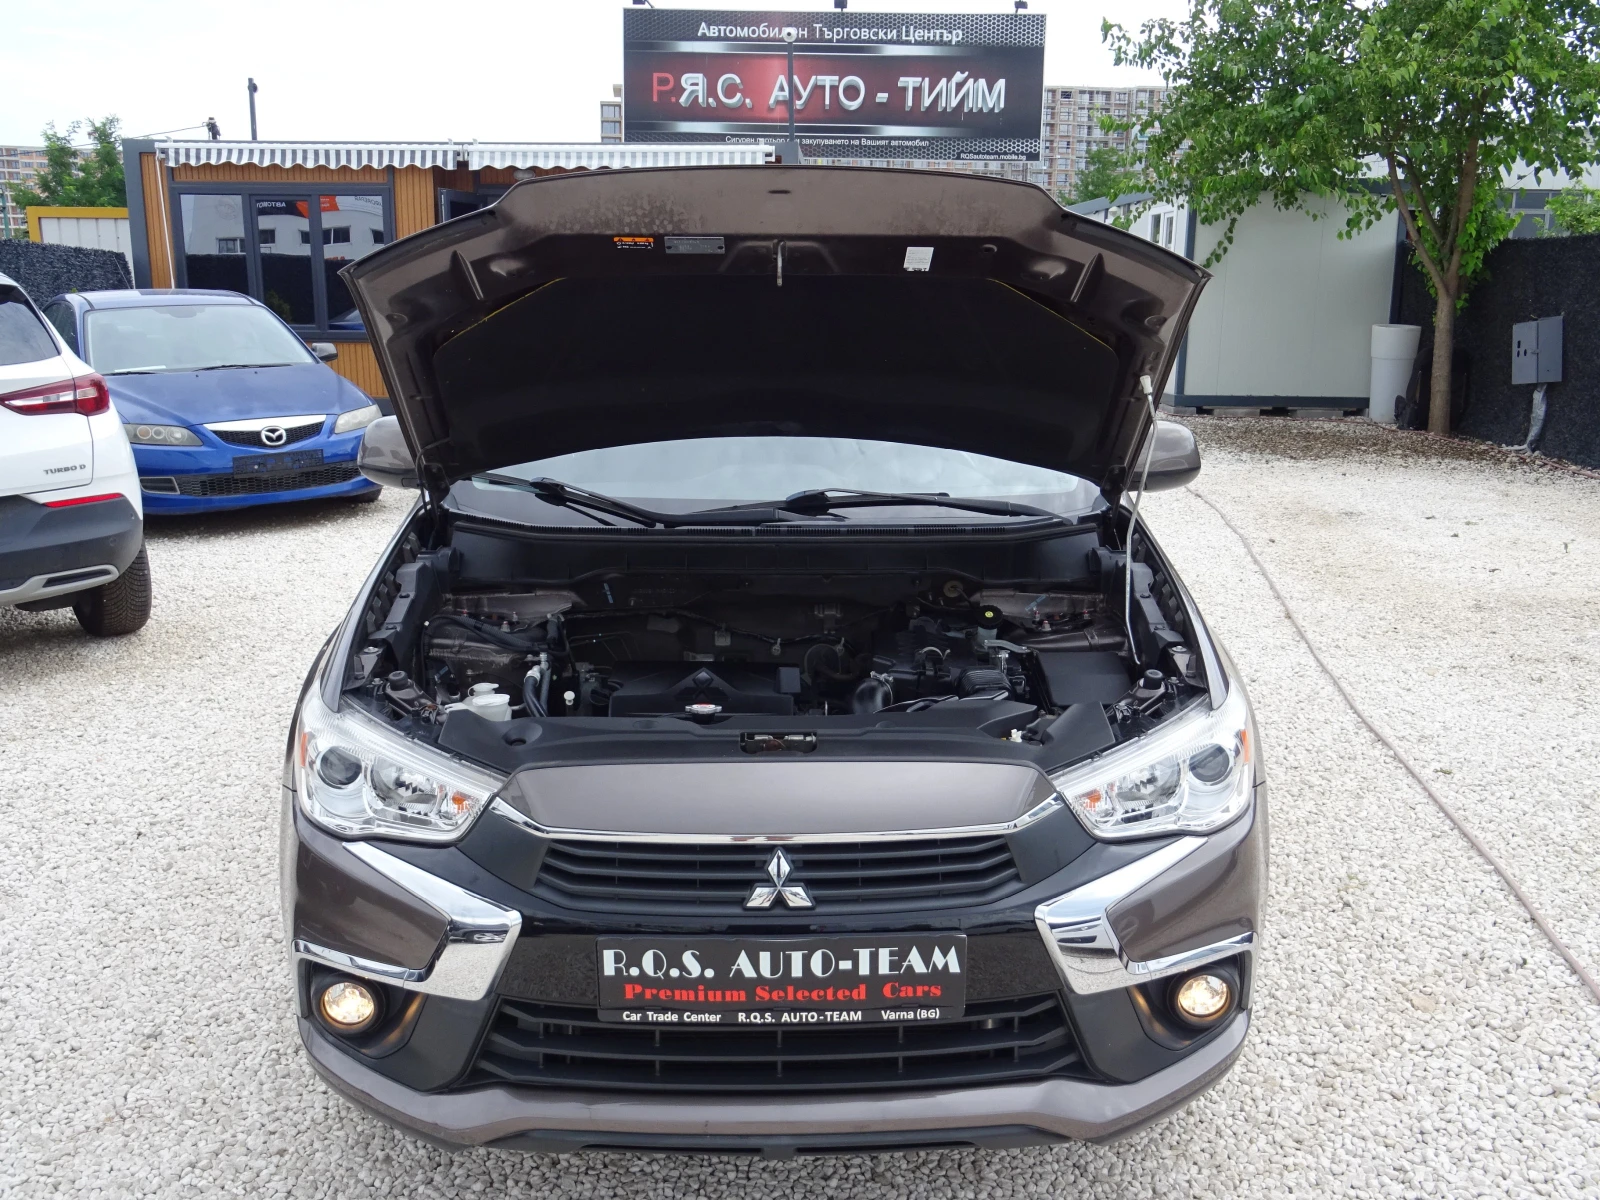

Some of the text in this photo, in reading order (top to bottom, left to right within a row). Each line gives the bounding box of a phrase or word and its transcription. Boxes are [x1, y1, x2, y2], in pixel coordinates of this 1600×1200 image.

[697, 21, 963, 45] Автомобилн Търговски Център
[768, 75, 866, 111] АУТО
[897, 71, 1006, 113] ТИЙМ
[861, 138, 889, 146] Вашият
[890, 138, 929, 147] автомобил
[43, 465, 78, 475] TURBO
[602, 945, 961, 980] R.Q.S. AUTO-TEAM
[624, 982, 942, 1002] Premium Selected Cars
[622, 1011, 642, 1022] Car
[646, 1011, 679, 1022] Trade
[683, 1012, 722, 1023] Center
[738, 1012, 776, 1024] R.Q.S.
[881, 1010, 915, 1021] Varna
[916, 1008, 940, 1020] (BG)
